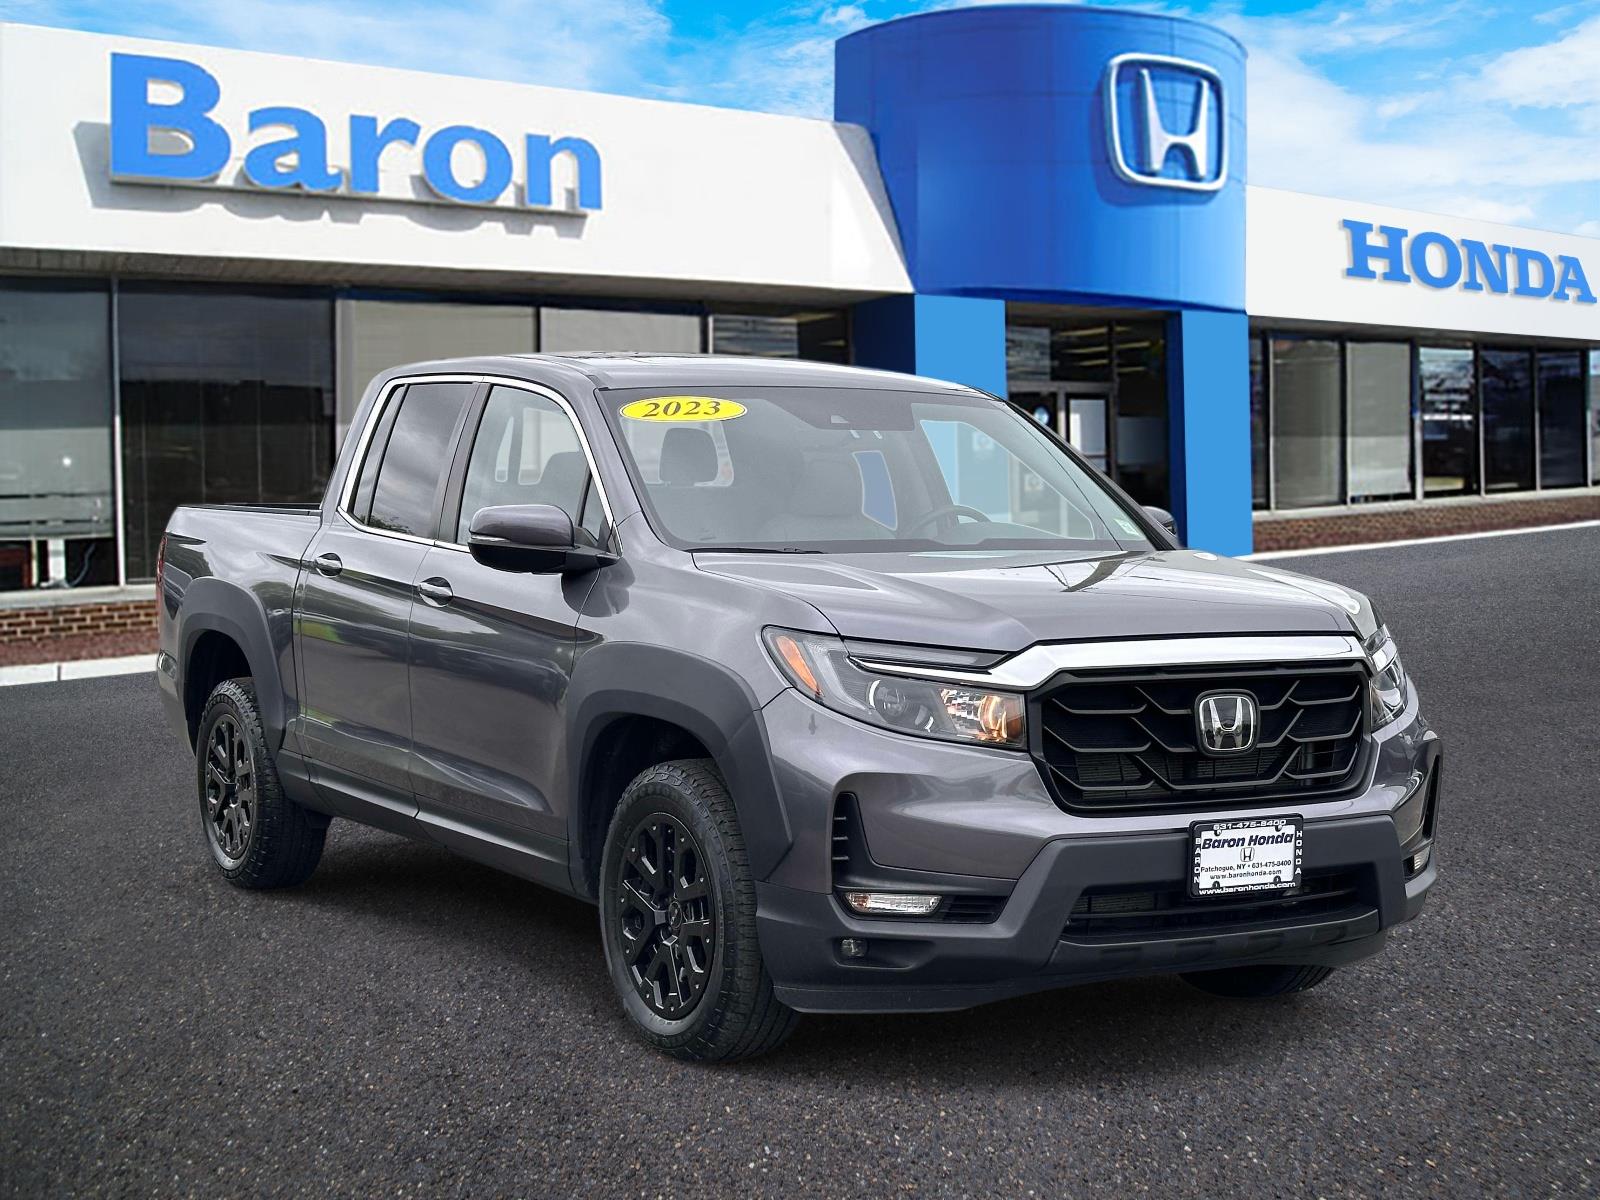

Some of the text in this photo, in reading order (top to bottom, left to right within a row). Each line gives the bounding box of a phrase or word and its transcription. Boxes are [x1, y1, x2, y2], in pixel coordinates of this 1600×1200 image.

[111, 52, 602, 211] Baron
[1342, 219, 1597, 304] HONDA
[641, 400, 721, 418] 2023
[1213, 819, 1286, 831] 631-475-8400
[1202, 832, 1294, 850] Baron Honda
[1295, 830, 1303, 875] HONDA
[1198, 882, 1296, 895] www.baronhonda.com
